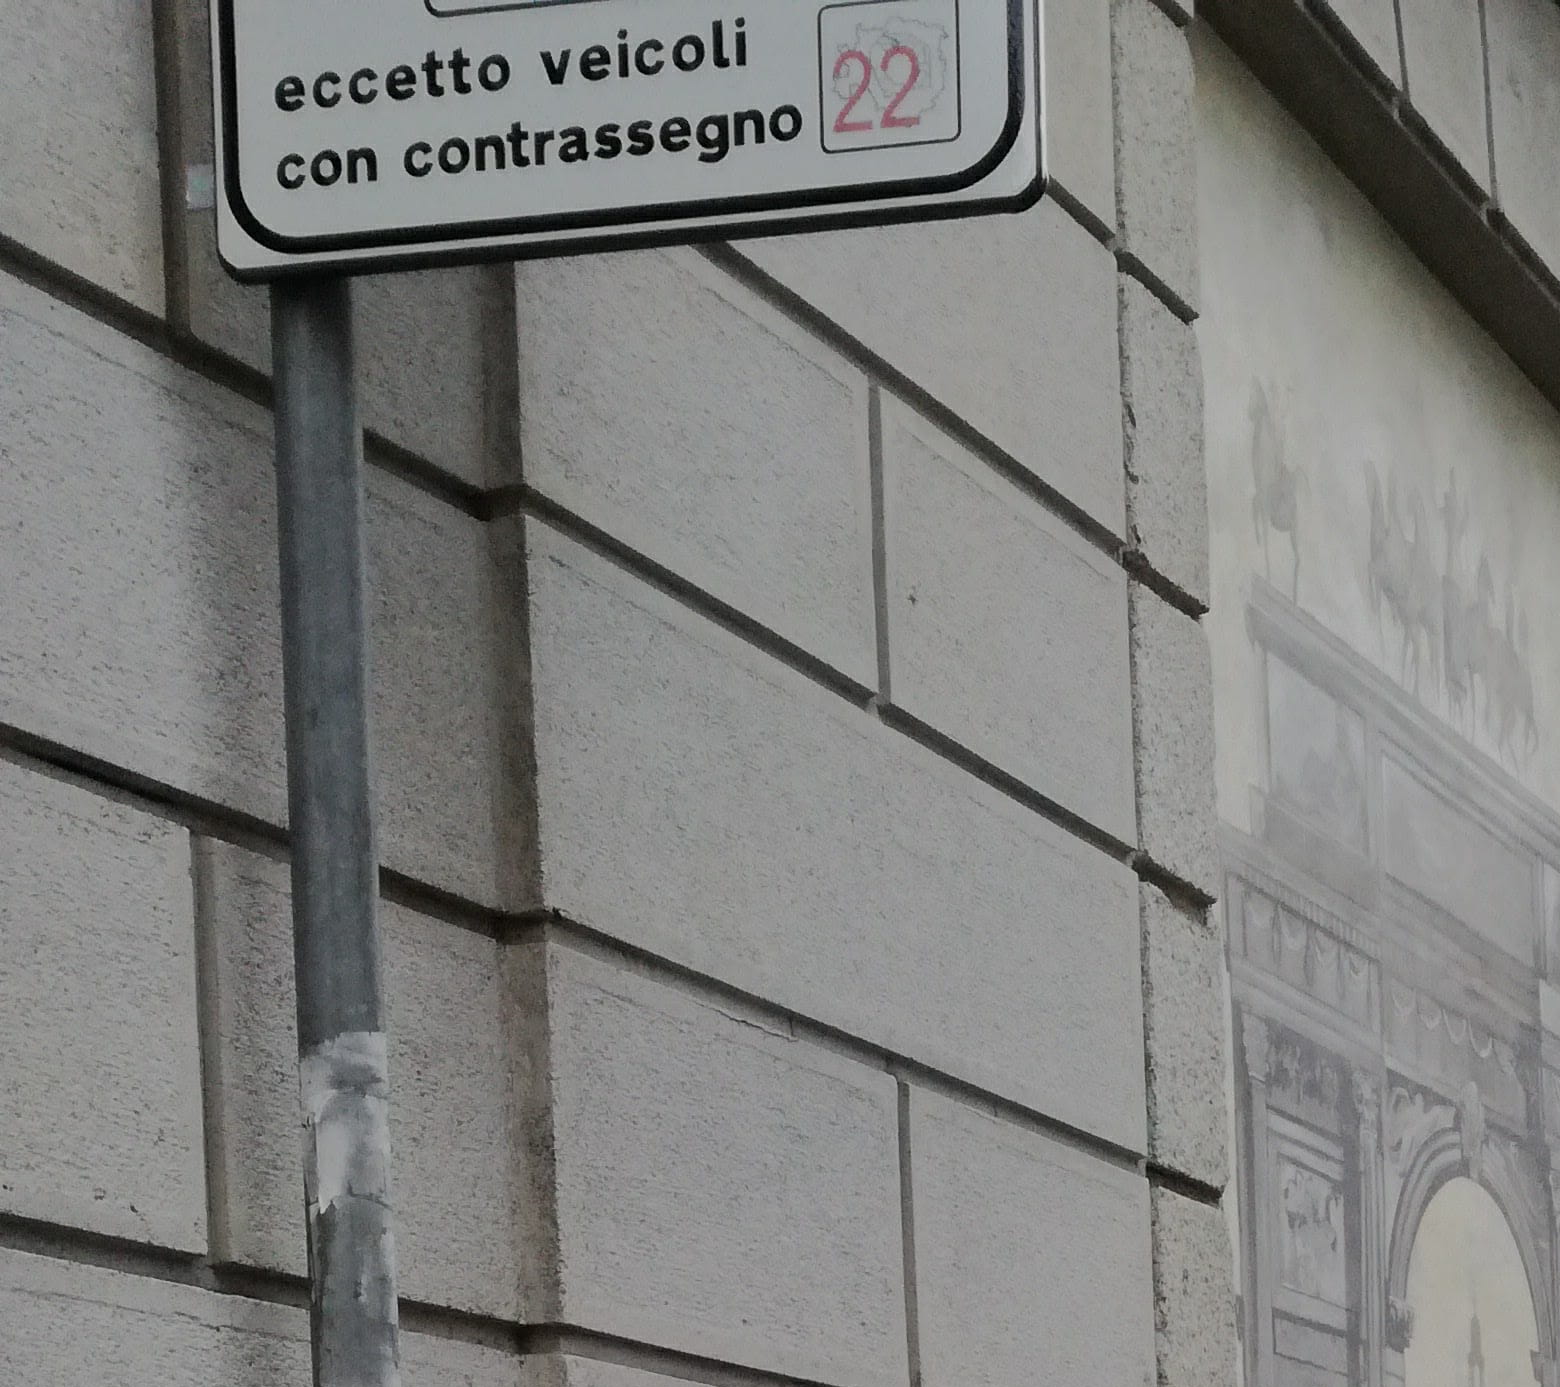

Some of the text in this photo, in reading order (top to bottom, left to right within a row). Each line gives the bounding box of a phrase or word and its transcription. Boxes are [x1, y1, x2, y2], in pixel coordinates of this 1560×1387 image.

[274, 17, 747, 112] eccetto veicoli
[832, 46, 922, 133] 22
[276, 104, 803, 190] con contrassegno
